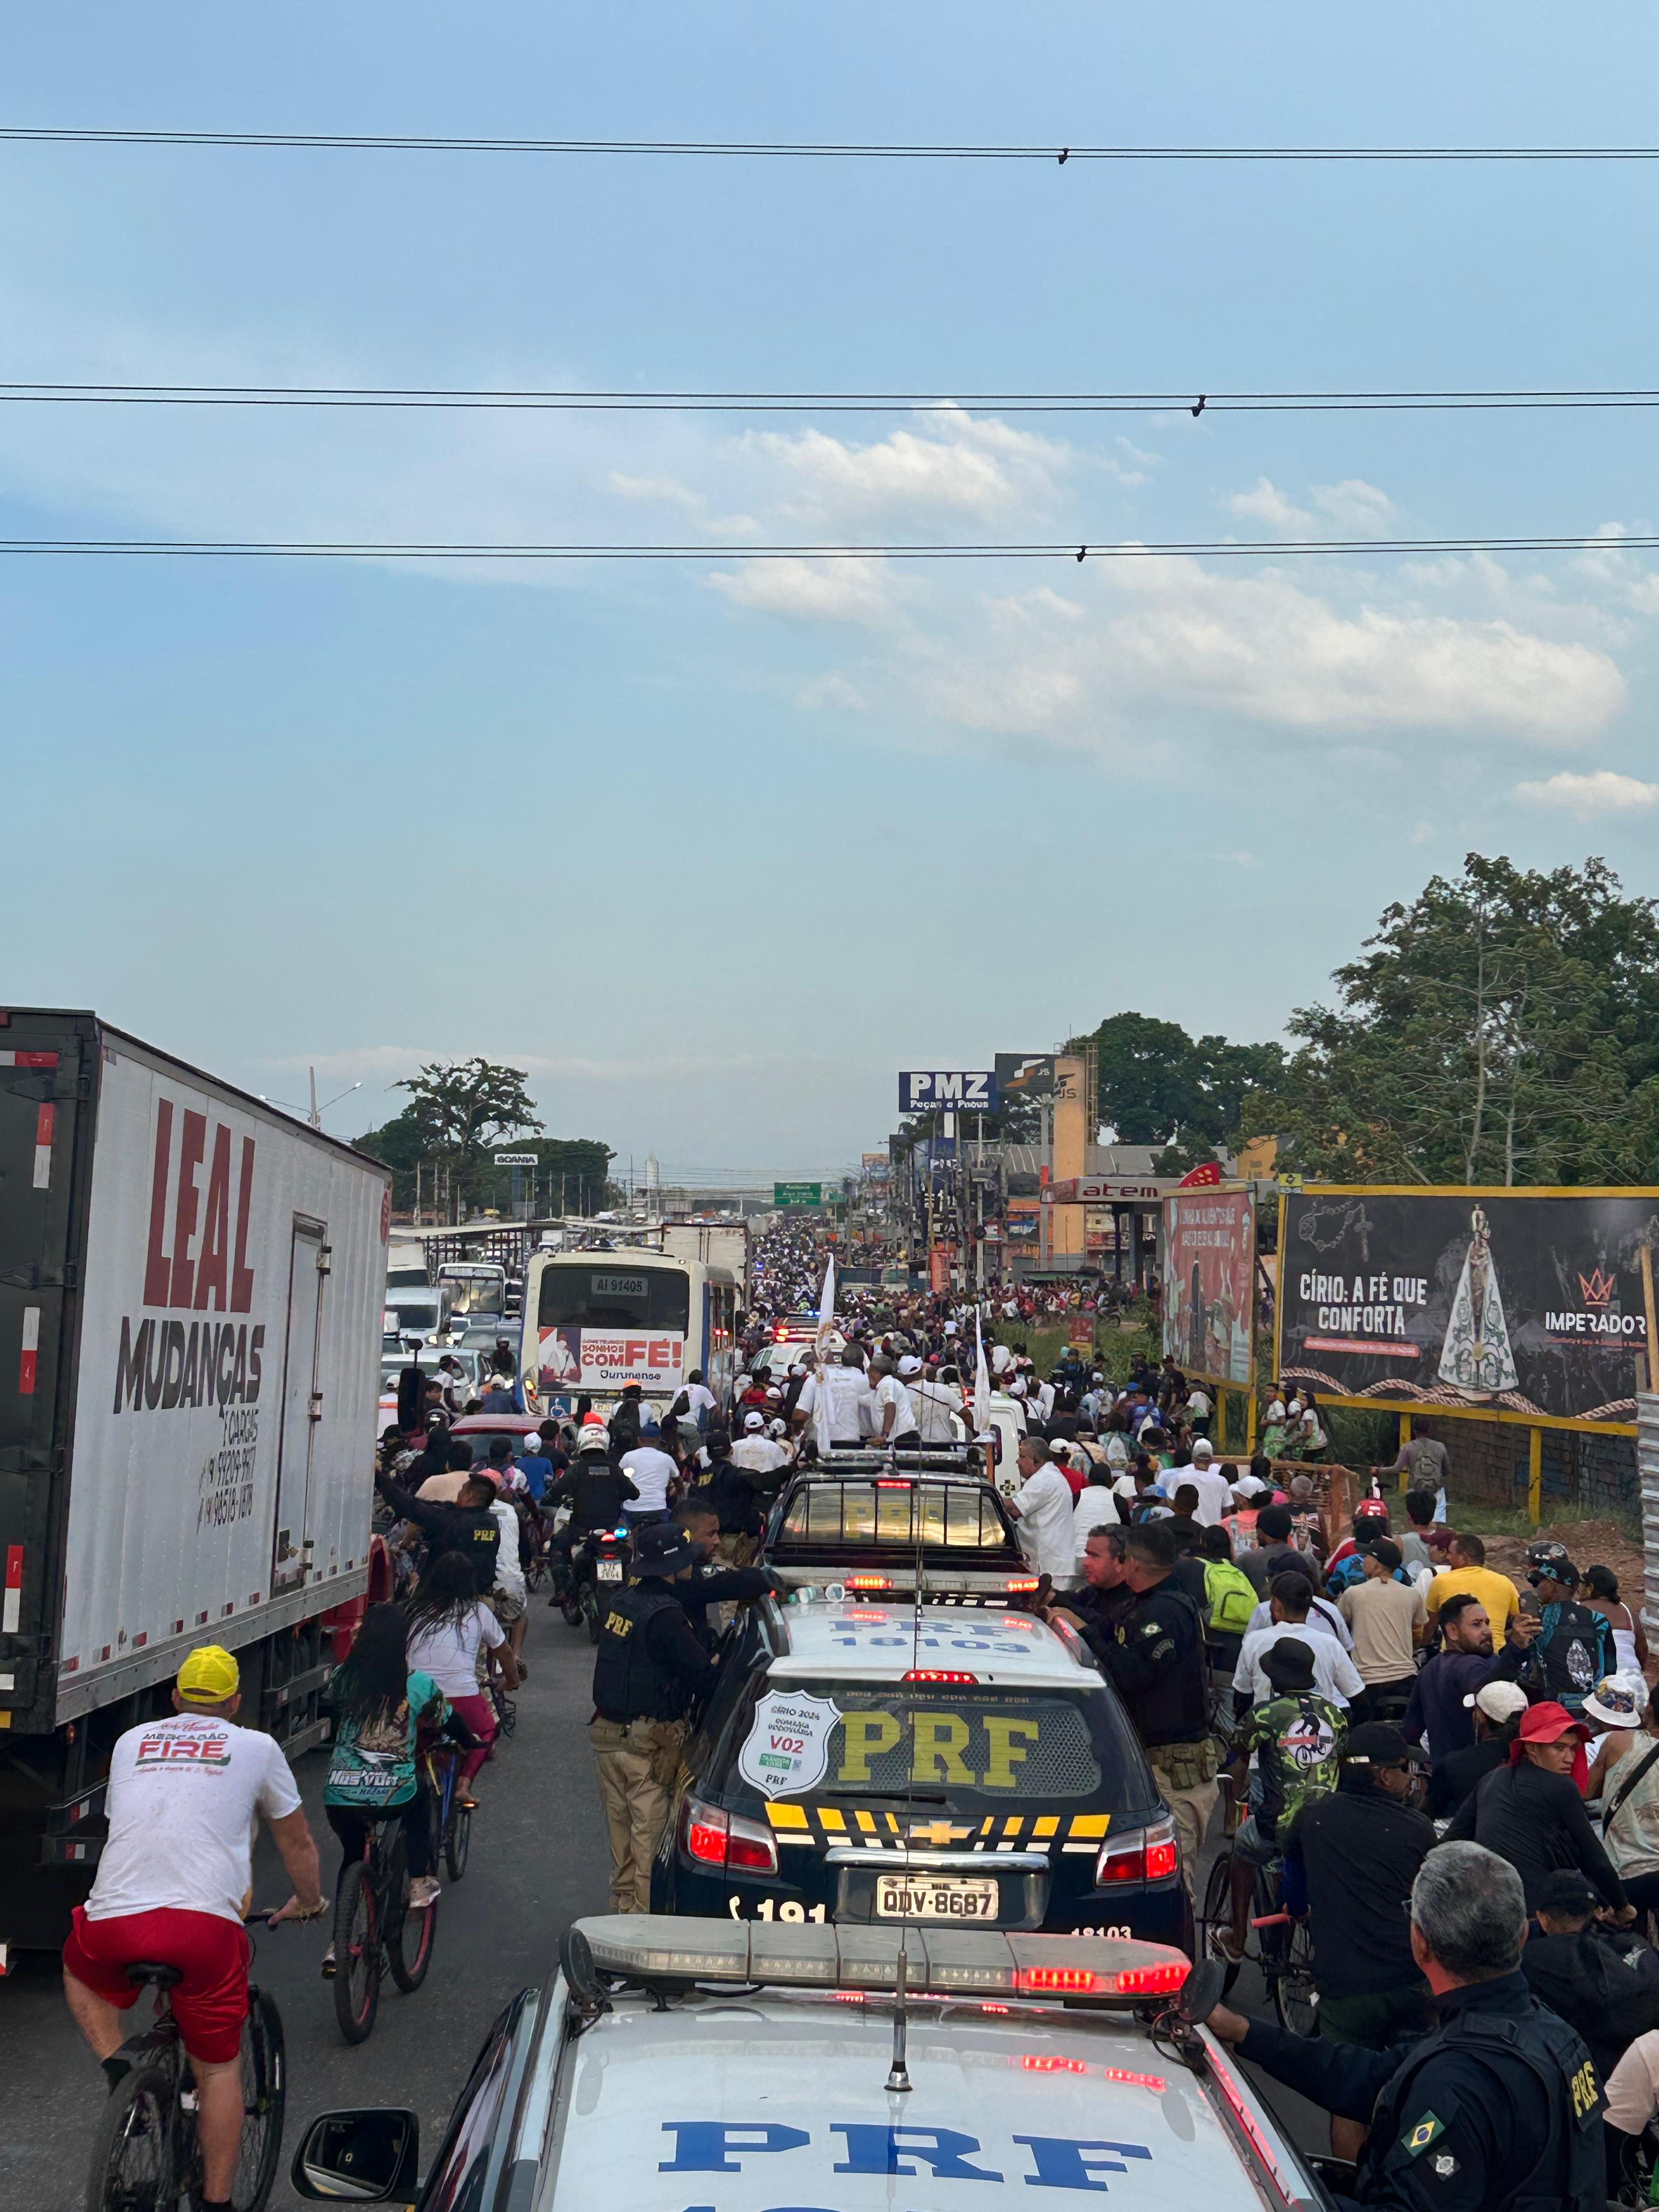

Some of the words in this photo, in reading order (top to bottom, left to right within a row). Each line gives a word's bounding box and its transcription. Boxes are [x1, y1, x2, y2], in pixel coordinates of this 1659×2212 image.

[910, 1074, 988, 1099] PMZ
[1082, 1182, 1159, 1198] atem
[143, 1097, 255, 1313] LEAL
[1300, 1268, 1348, 1304] CÍRIO:
[1352, 1276, 1364, 1303] A
[1369, 1271, 1389, 1302] FÉ
[1393, 1277, 1428, 1306] QUE
[1318, 1306, 1406, 1335] CONFORTA
[1545, 1312, 1646, 1335] IMPERADOR
[582, 1353, 624, 1367] COM
[625, 1338, 682, 1369] FÉ!
[473, 1529, 496, 1542] PRF
[605, 1611, 633, 1638] PRF
[828, 1620, 1019, 1637] PRF
[138, 1740, 227, 1759] FIRE
[838, 1711, 1039, 1788] PRF
[765, 1774, 788, 1786] PRF
[757, 1899, 826, 1925] 191
[1571, 2061, 1599, 2118] PRF
[658, 2121, 1153, 2192] PRF
